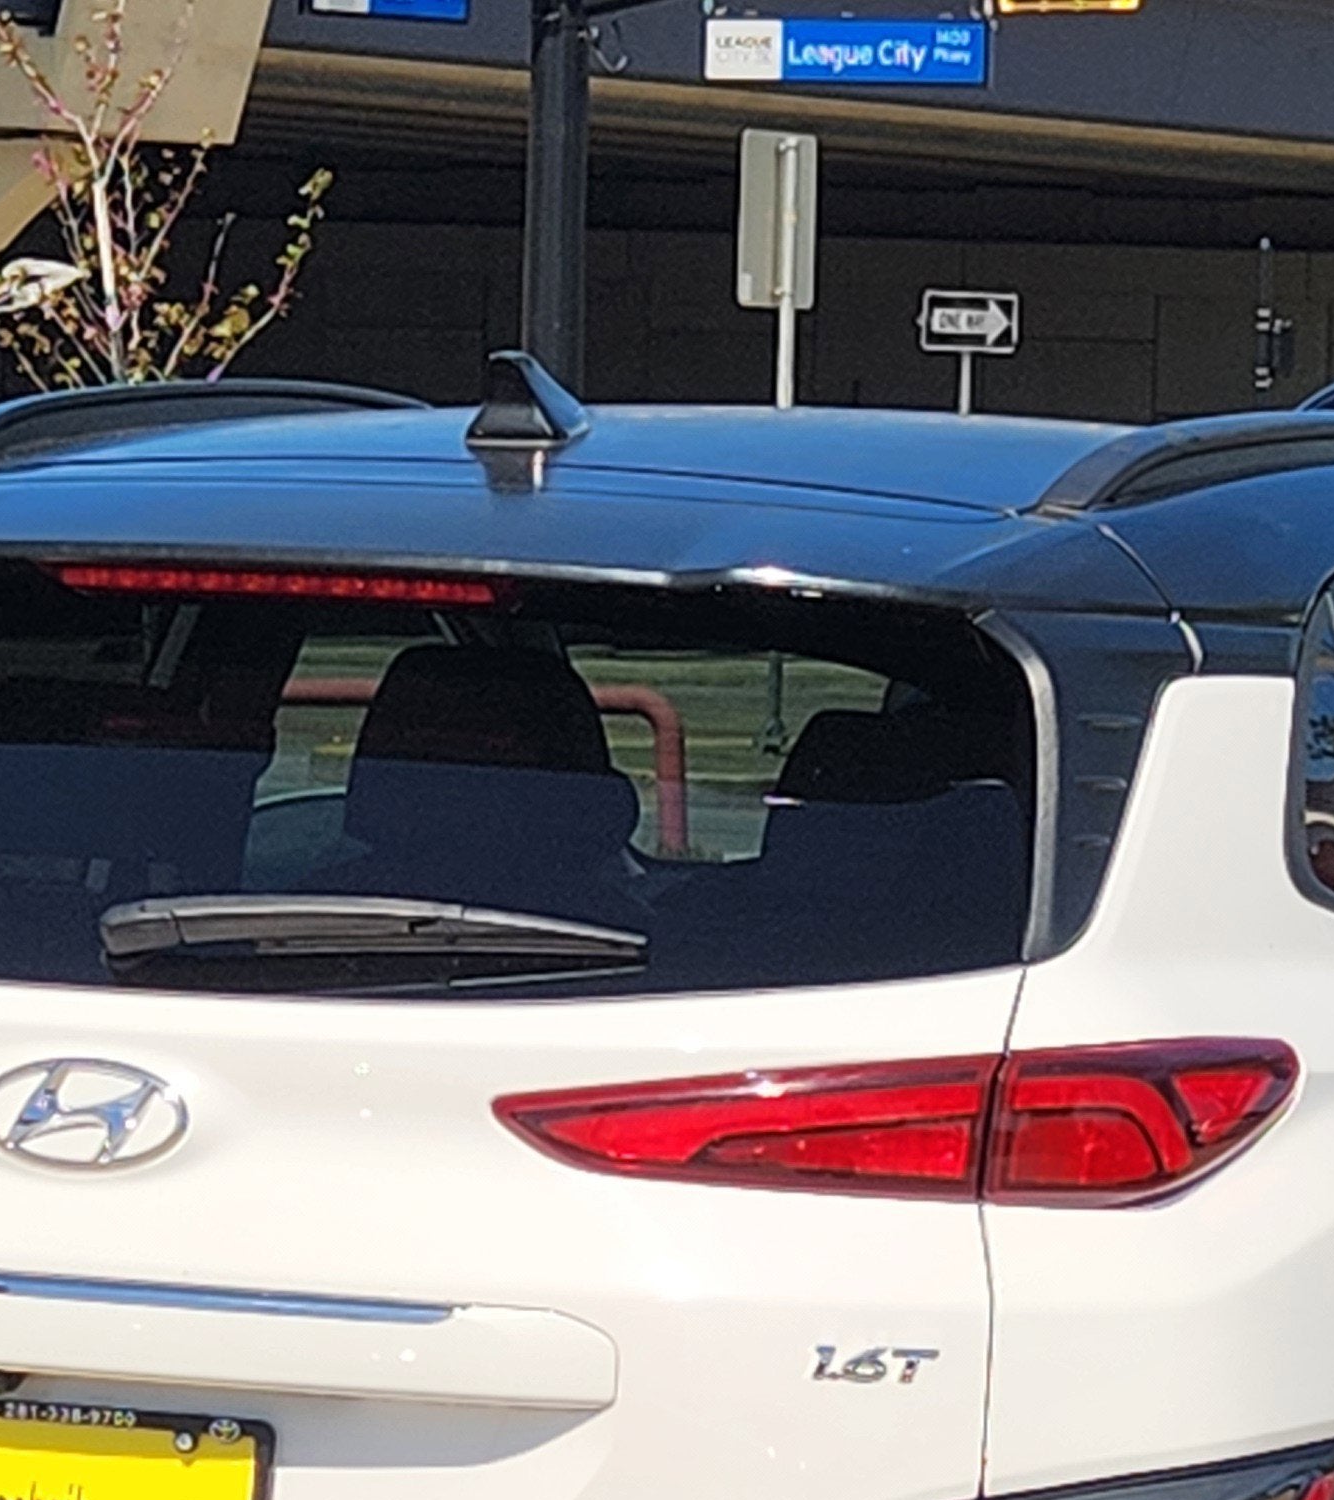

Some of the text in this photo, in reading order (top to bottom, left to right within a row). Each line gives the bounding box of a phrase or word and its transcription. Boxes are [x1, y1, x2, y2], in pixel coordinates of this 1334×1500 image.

[715, 36, 772, 49] LEAGUE
[787, 39, 926, 73] League City
